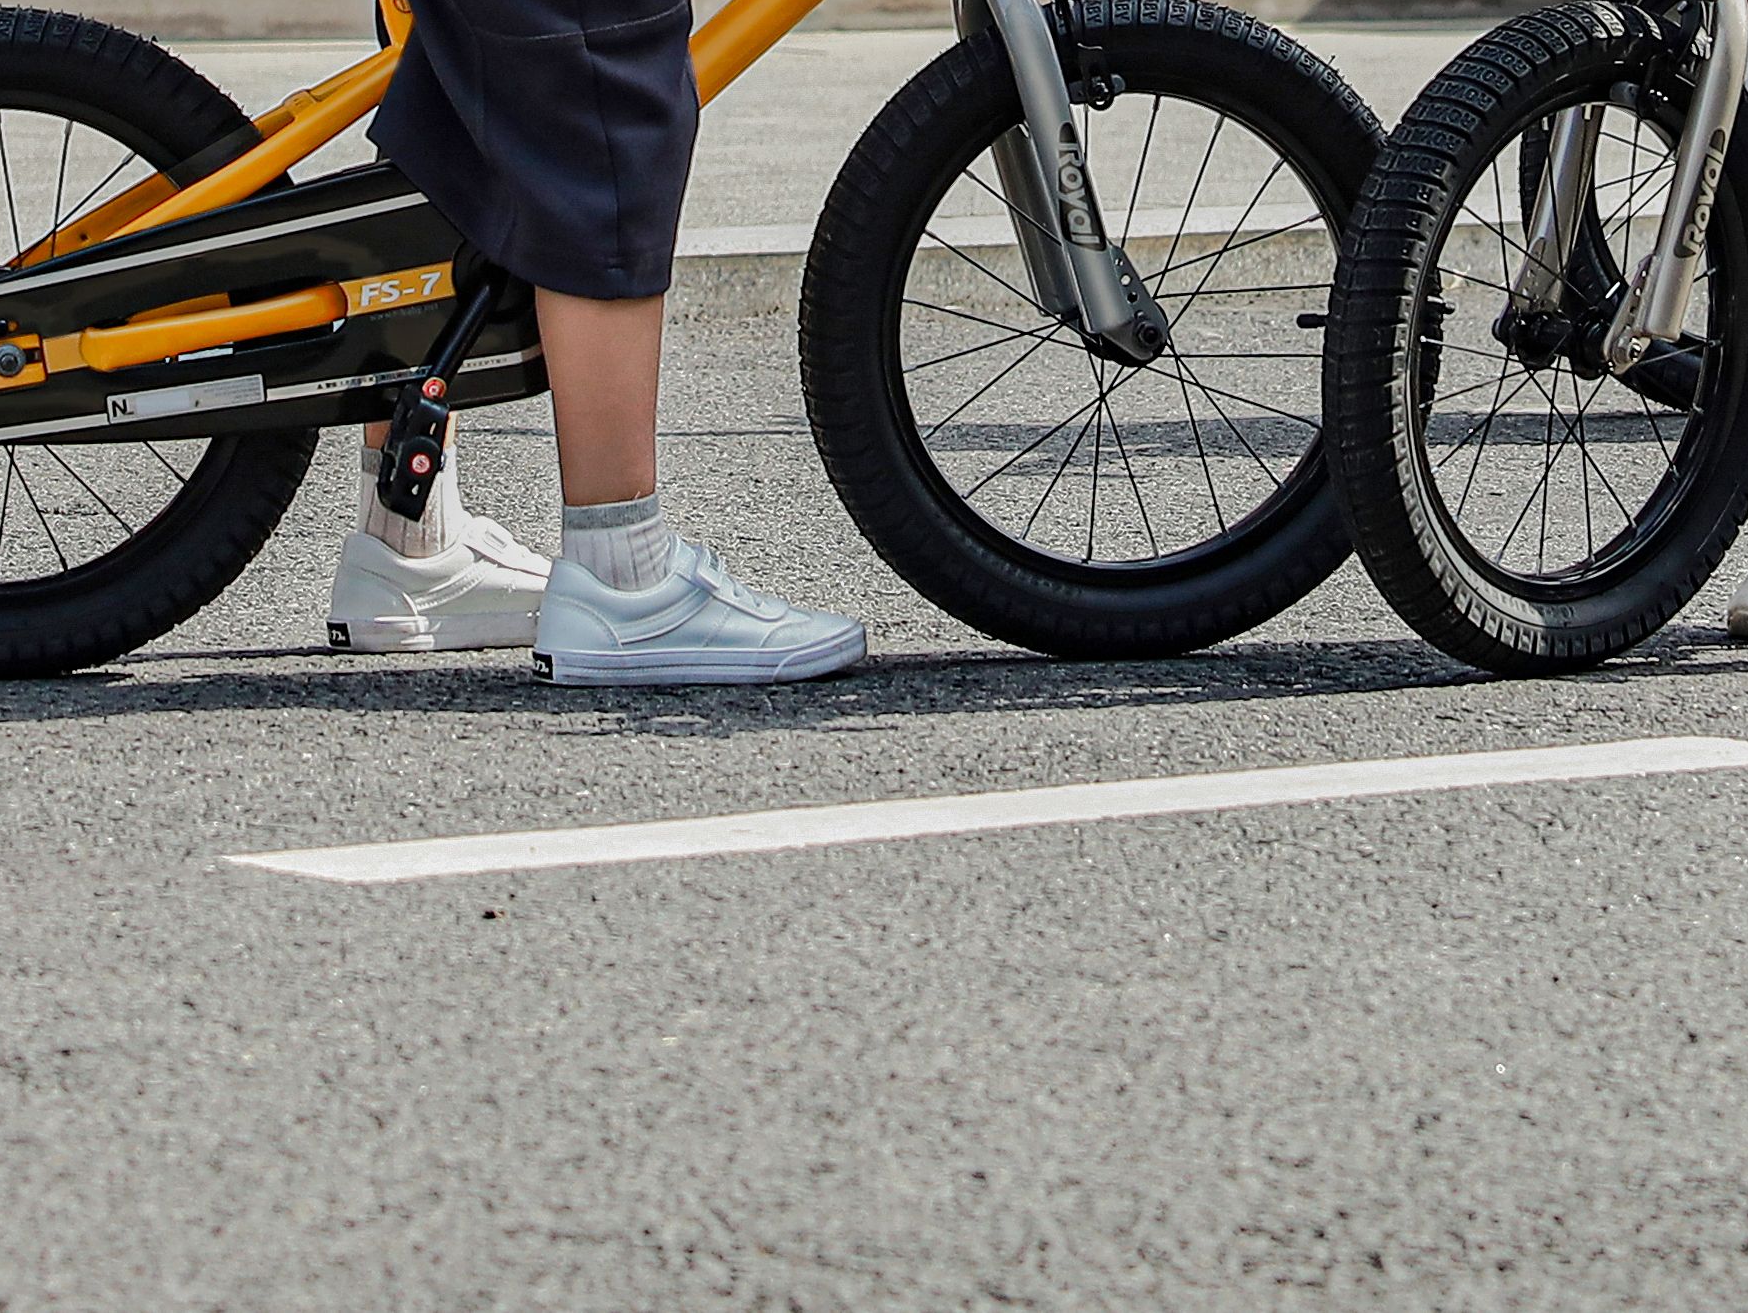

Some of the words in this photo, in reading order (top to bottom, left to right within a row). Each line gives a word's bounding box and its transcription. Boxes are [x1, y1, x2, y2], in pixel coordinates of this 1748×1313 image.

[1058, 141, 1102, 245] Royal
[1681, 145, 1724, 256] Royal
[360, 272, 442, 307] FS-7
